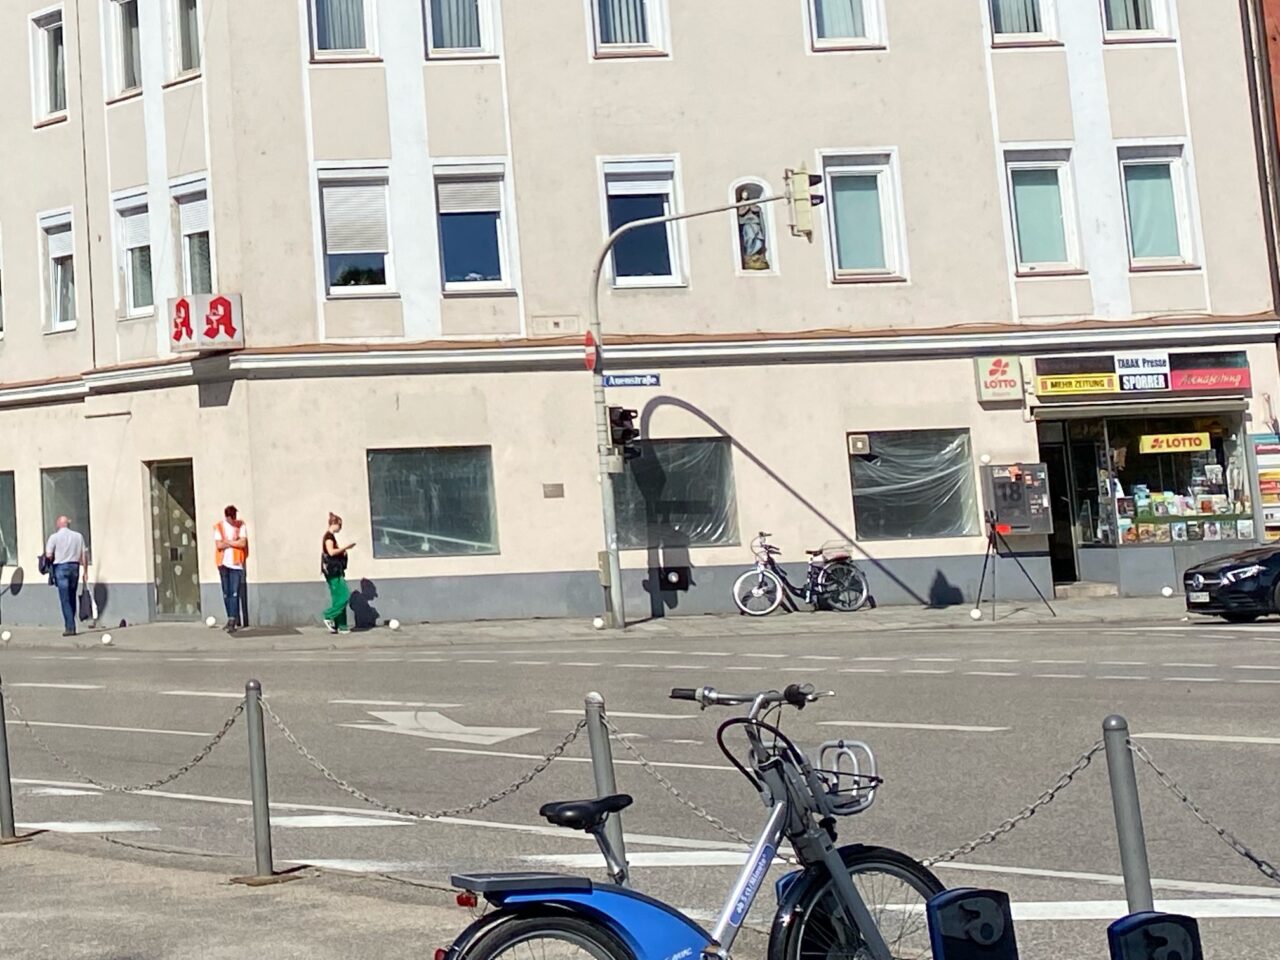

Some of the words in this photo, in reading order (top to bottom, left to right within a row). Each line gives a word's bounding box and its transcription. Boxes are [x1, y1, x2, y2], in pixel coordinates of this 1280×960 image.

[1142, 357, 1167, 368] Presse
[608, 374, 658, 386] Auenstraße
[984, 379, 1017, 389] LOTTO
[1122, 375, 1166, 390] SPORRER
[1165, 436, 1203, 448] LOTTO
